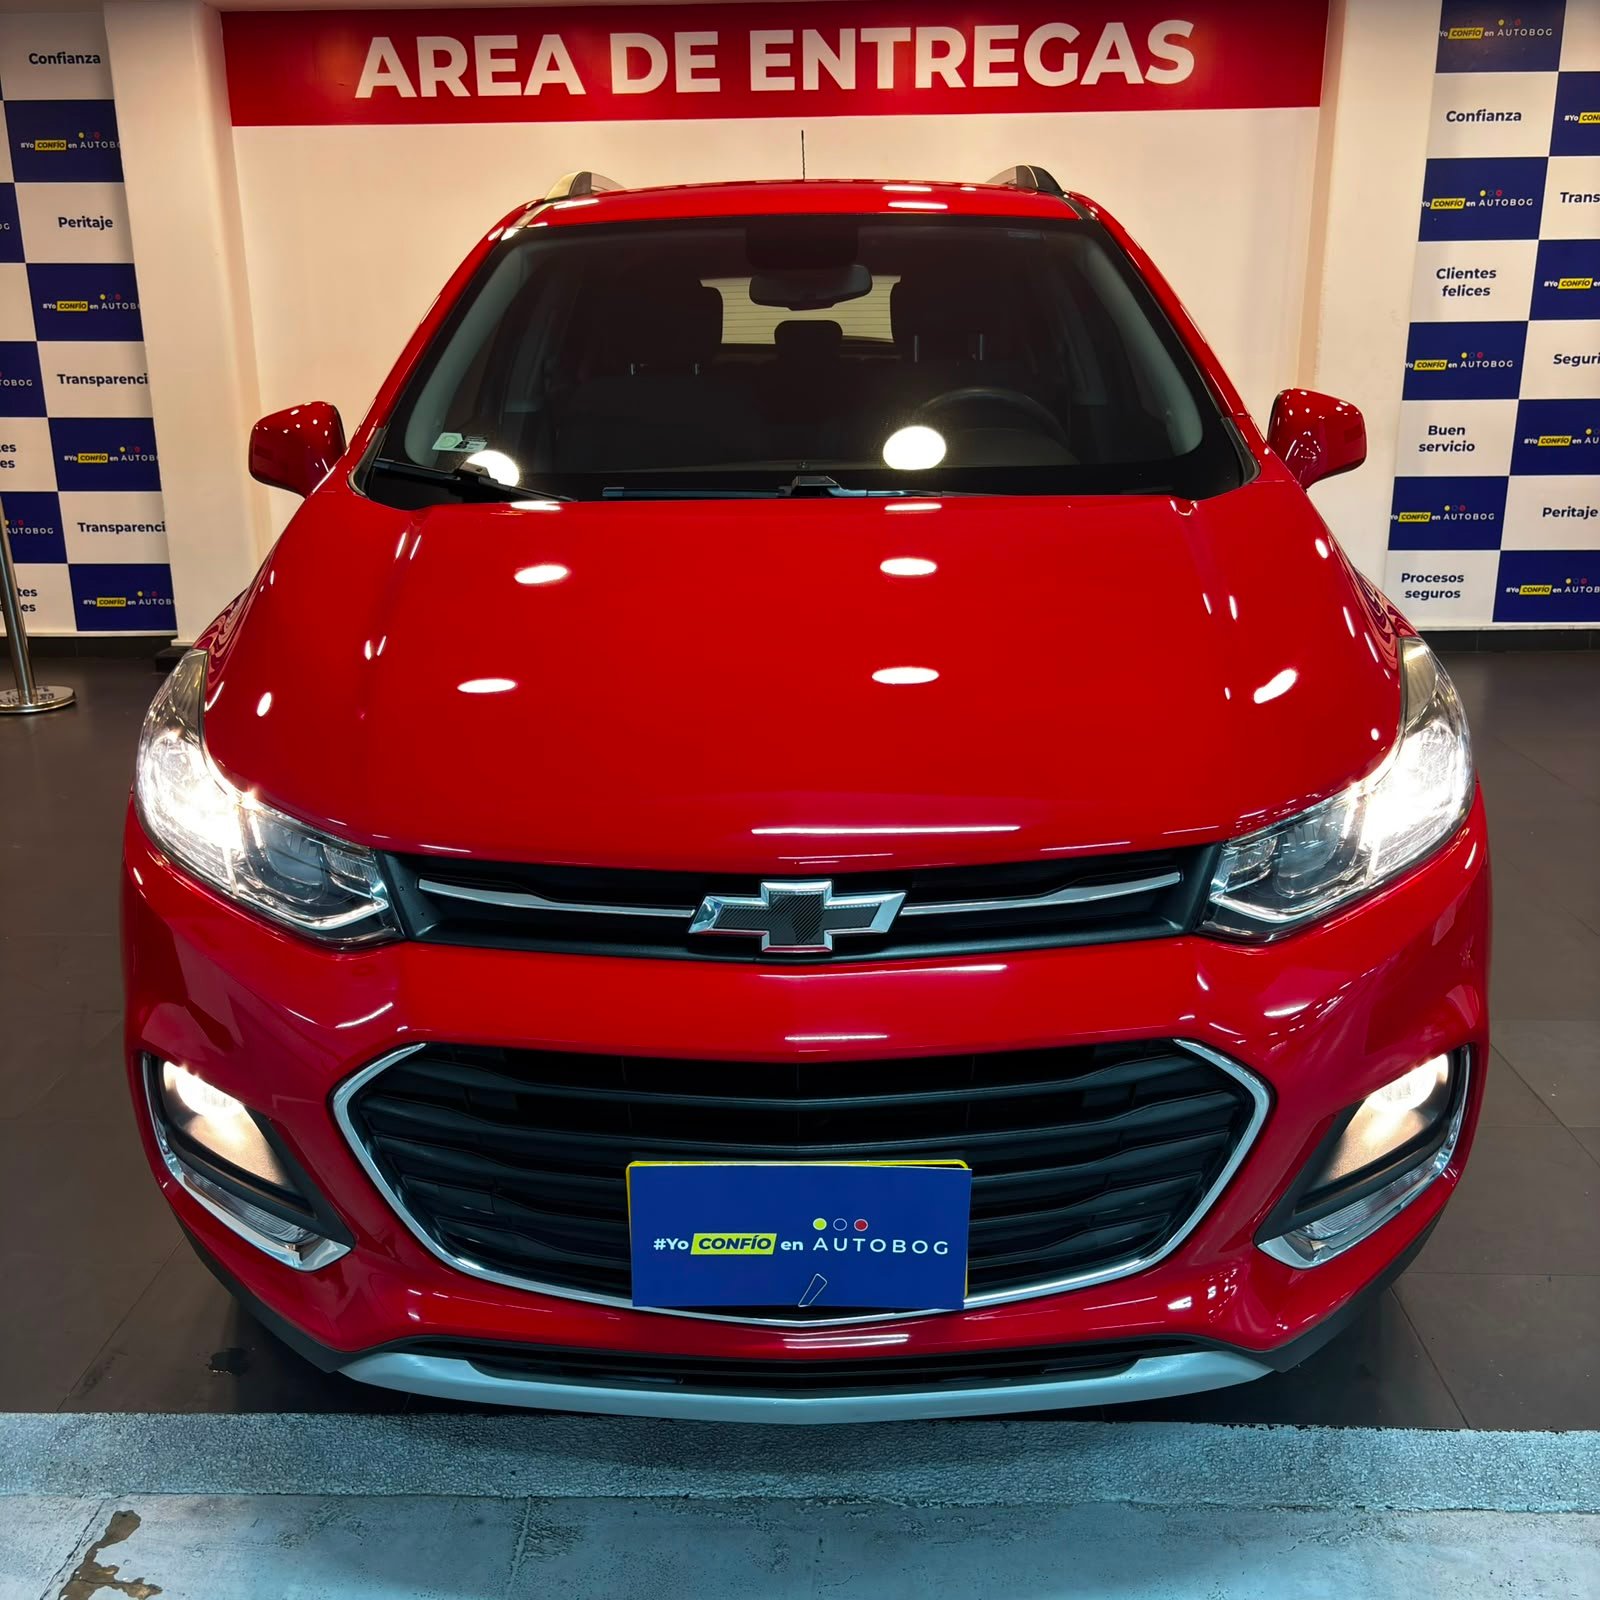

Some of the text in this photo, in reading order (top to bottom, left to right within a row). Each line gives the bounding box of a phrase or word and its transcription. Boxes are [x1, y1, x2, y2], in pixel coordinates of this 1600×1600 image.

[1451, 29, 1481, 37] CONFÍO
[1497, 28, 1552, 37] AUTOBOG
[29, 52, 101, 65] Confianza
[354, 19, 1195, 99] AREA DE ENTREGAS
[1446, 110, 1522, 122] Confianza
[1433, 199, 1463, 207] CONFÍO
[1479, 199, 1533, 207] AUTOBOG
[1560, 192, 1600, 203] Trans
[58, 216, 113, 230] Peritaje
[1436, 268, 1496, 280] Clientes
[1561, 279, 1590, 287] CONFÍO
[1441, 284, 1491, 297] felices
[1460, 360, 1513, 368] AUTOBOG
[57, 373, 148, 387] Transparenci
[1428, 425, 1465, 436] Buen
[1418, 440, 1475, 452] servicio
[1542, 506, 1598, 520] Peritaje
[77, 521, 166, 534] Transparenci
[1401, 572, 1464, 584] Procesos
[1405, 589, 1461, 600] seguros
[1522, 585, 1550, 593] CONFÍO
[653, 1235, 949, 1255] #Yo CONFÍO en AUTOBOG
